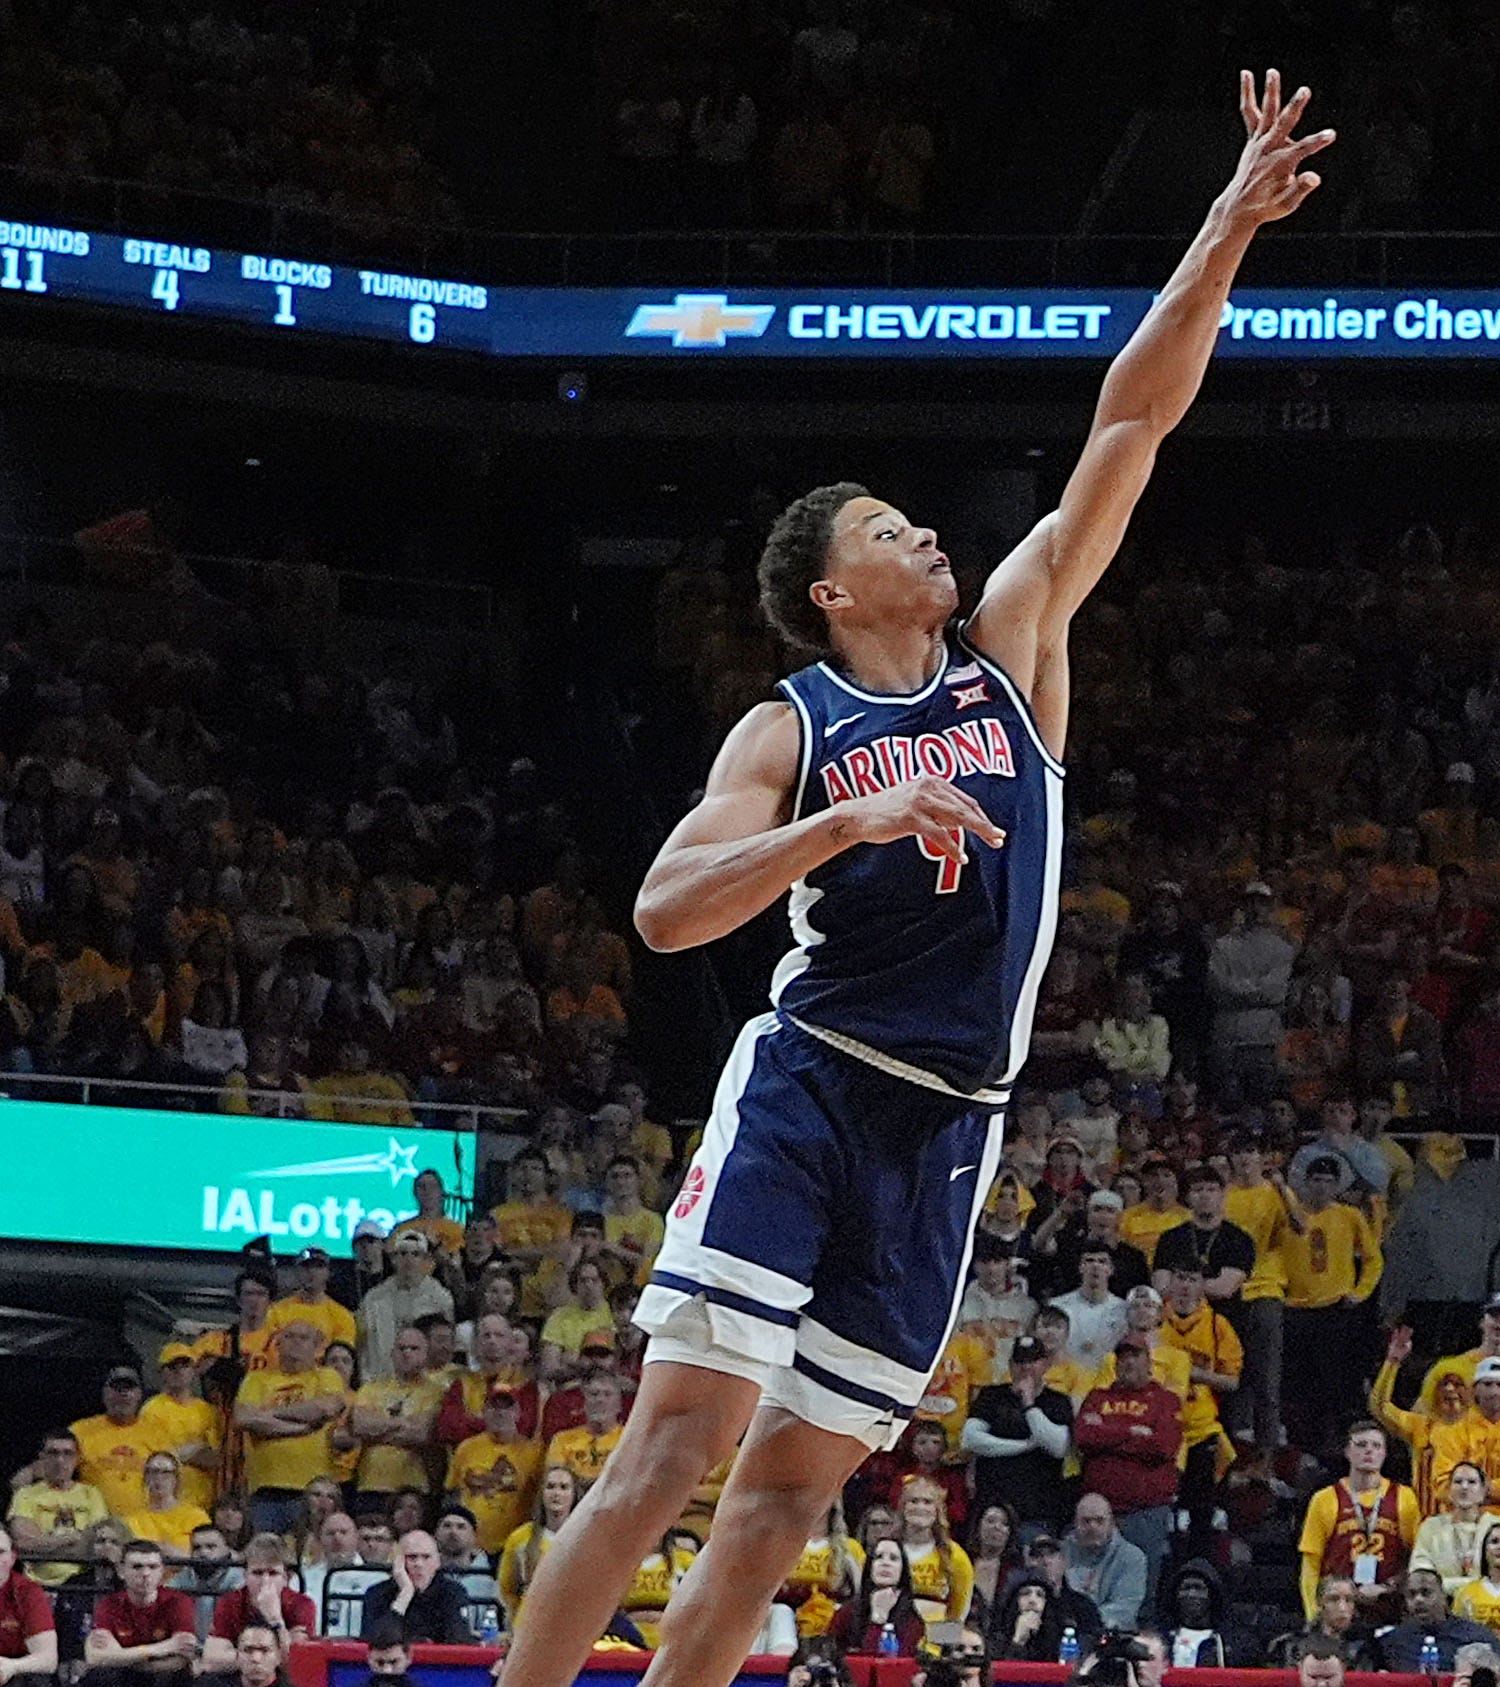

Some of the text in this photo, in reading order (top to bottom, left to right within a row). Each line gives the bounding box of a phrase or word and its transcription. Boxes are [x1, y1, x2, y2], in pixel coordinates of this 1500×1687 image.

[0, 247, 47, 293] 11
[123, 239, 210, 272] STEALS
[241, 255, 331, 288] BLOCKS
[151, 271, 180, 310] 4
[274, 285, 296, 325] 1
[359, 271, 487, 310] TURNOVERS
[409, 304, 436, 343] 6
[788, 305, 1111, 339] CHEVROLET
[819, 718, 1016, 805] ARIZONA
[203, 1186, 420, 1239] IALotte
